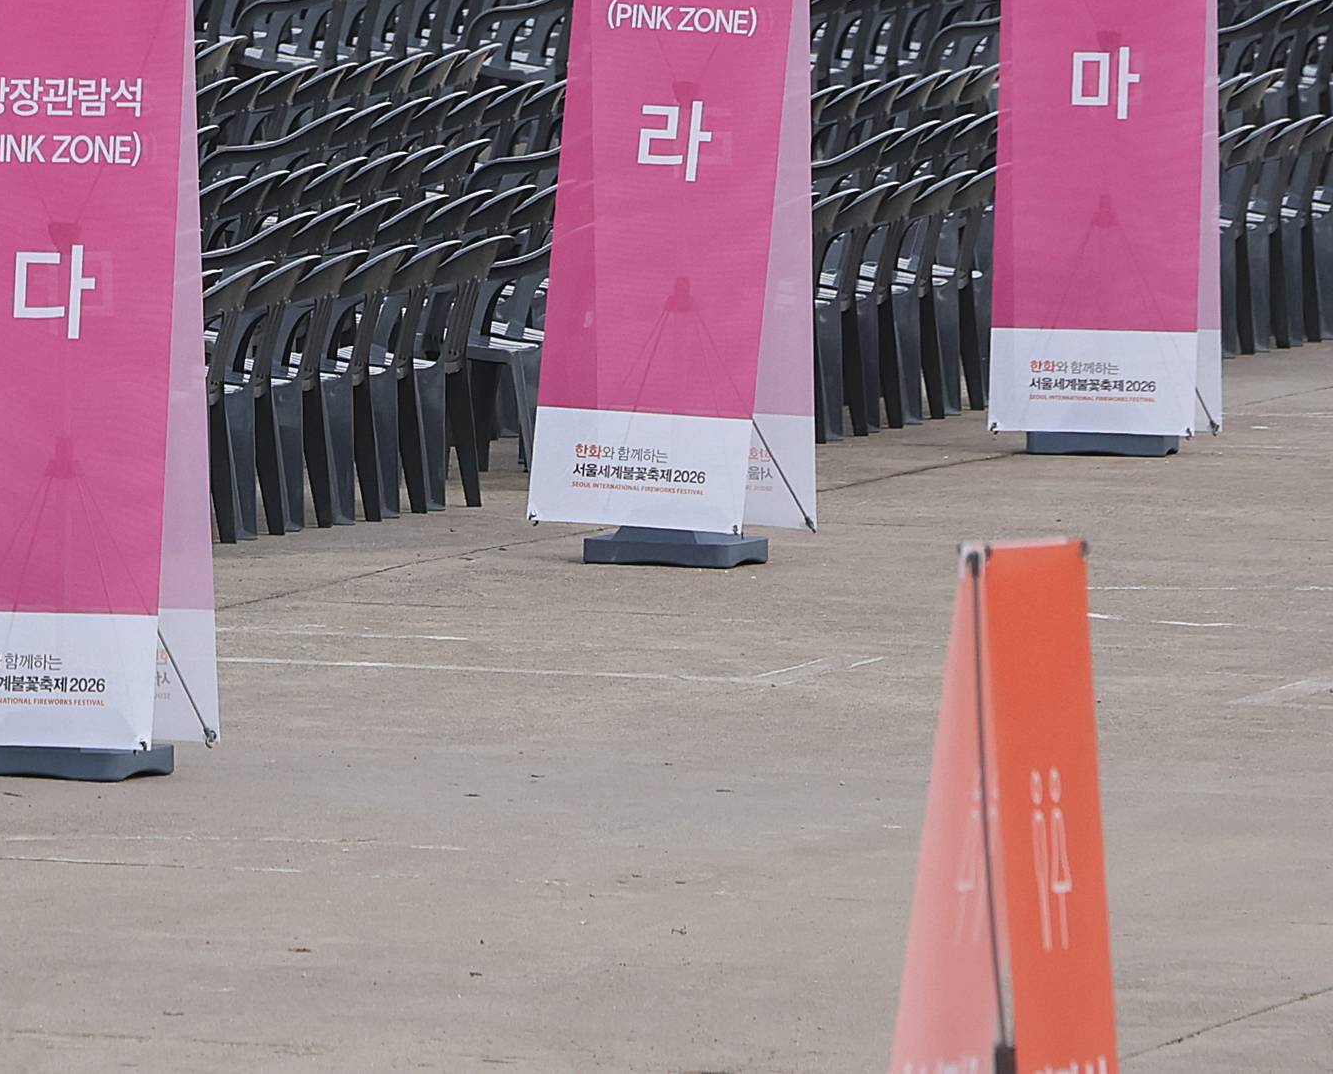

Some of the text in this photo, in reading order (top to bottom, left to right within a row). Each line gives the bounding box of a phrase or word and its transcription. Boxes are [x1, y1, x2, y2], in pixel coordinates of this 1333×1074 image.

[607, 0, 757, 37] (PINK ZONE)
[1071, 46, 1140, 120] 마
[51, 130, 142, 166] ZONE)
[637, 100, 712, 182] 라
[13, 245, 96, 339] 다
[1030, 360, 1068, 375] 한화와
[1125, 380, 1156, 393] 2026
[575, 443, 669, 464] 한화와 함께하는
[673, 470, 706, 484] 2026
[4, 652, 63, 671] 함께하는
[69, 677, 106, 693] 2026
[33, 697, 72, 705] FIREWORKS
[73, 698, 105, 706] FESTIVAL
